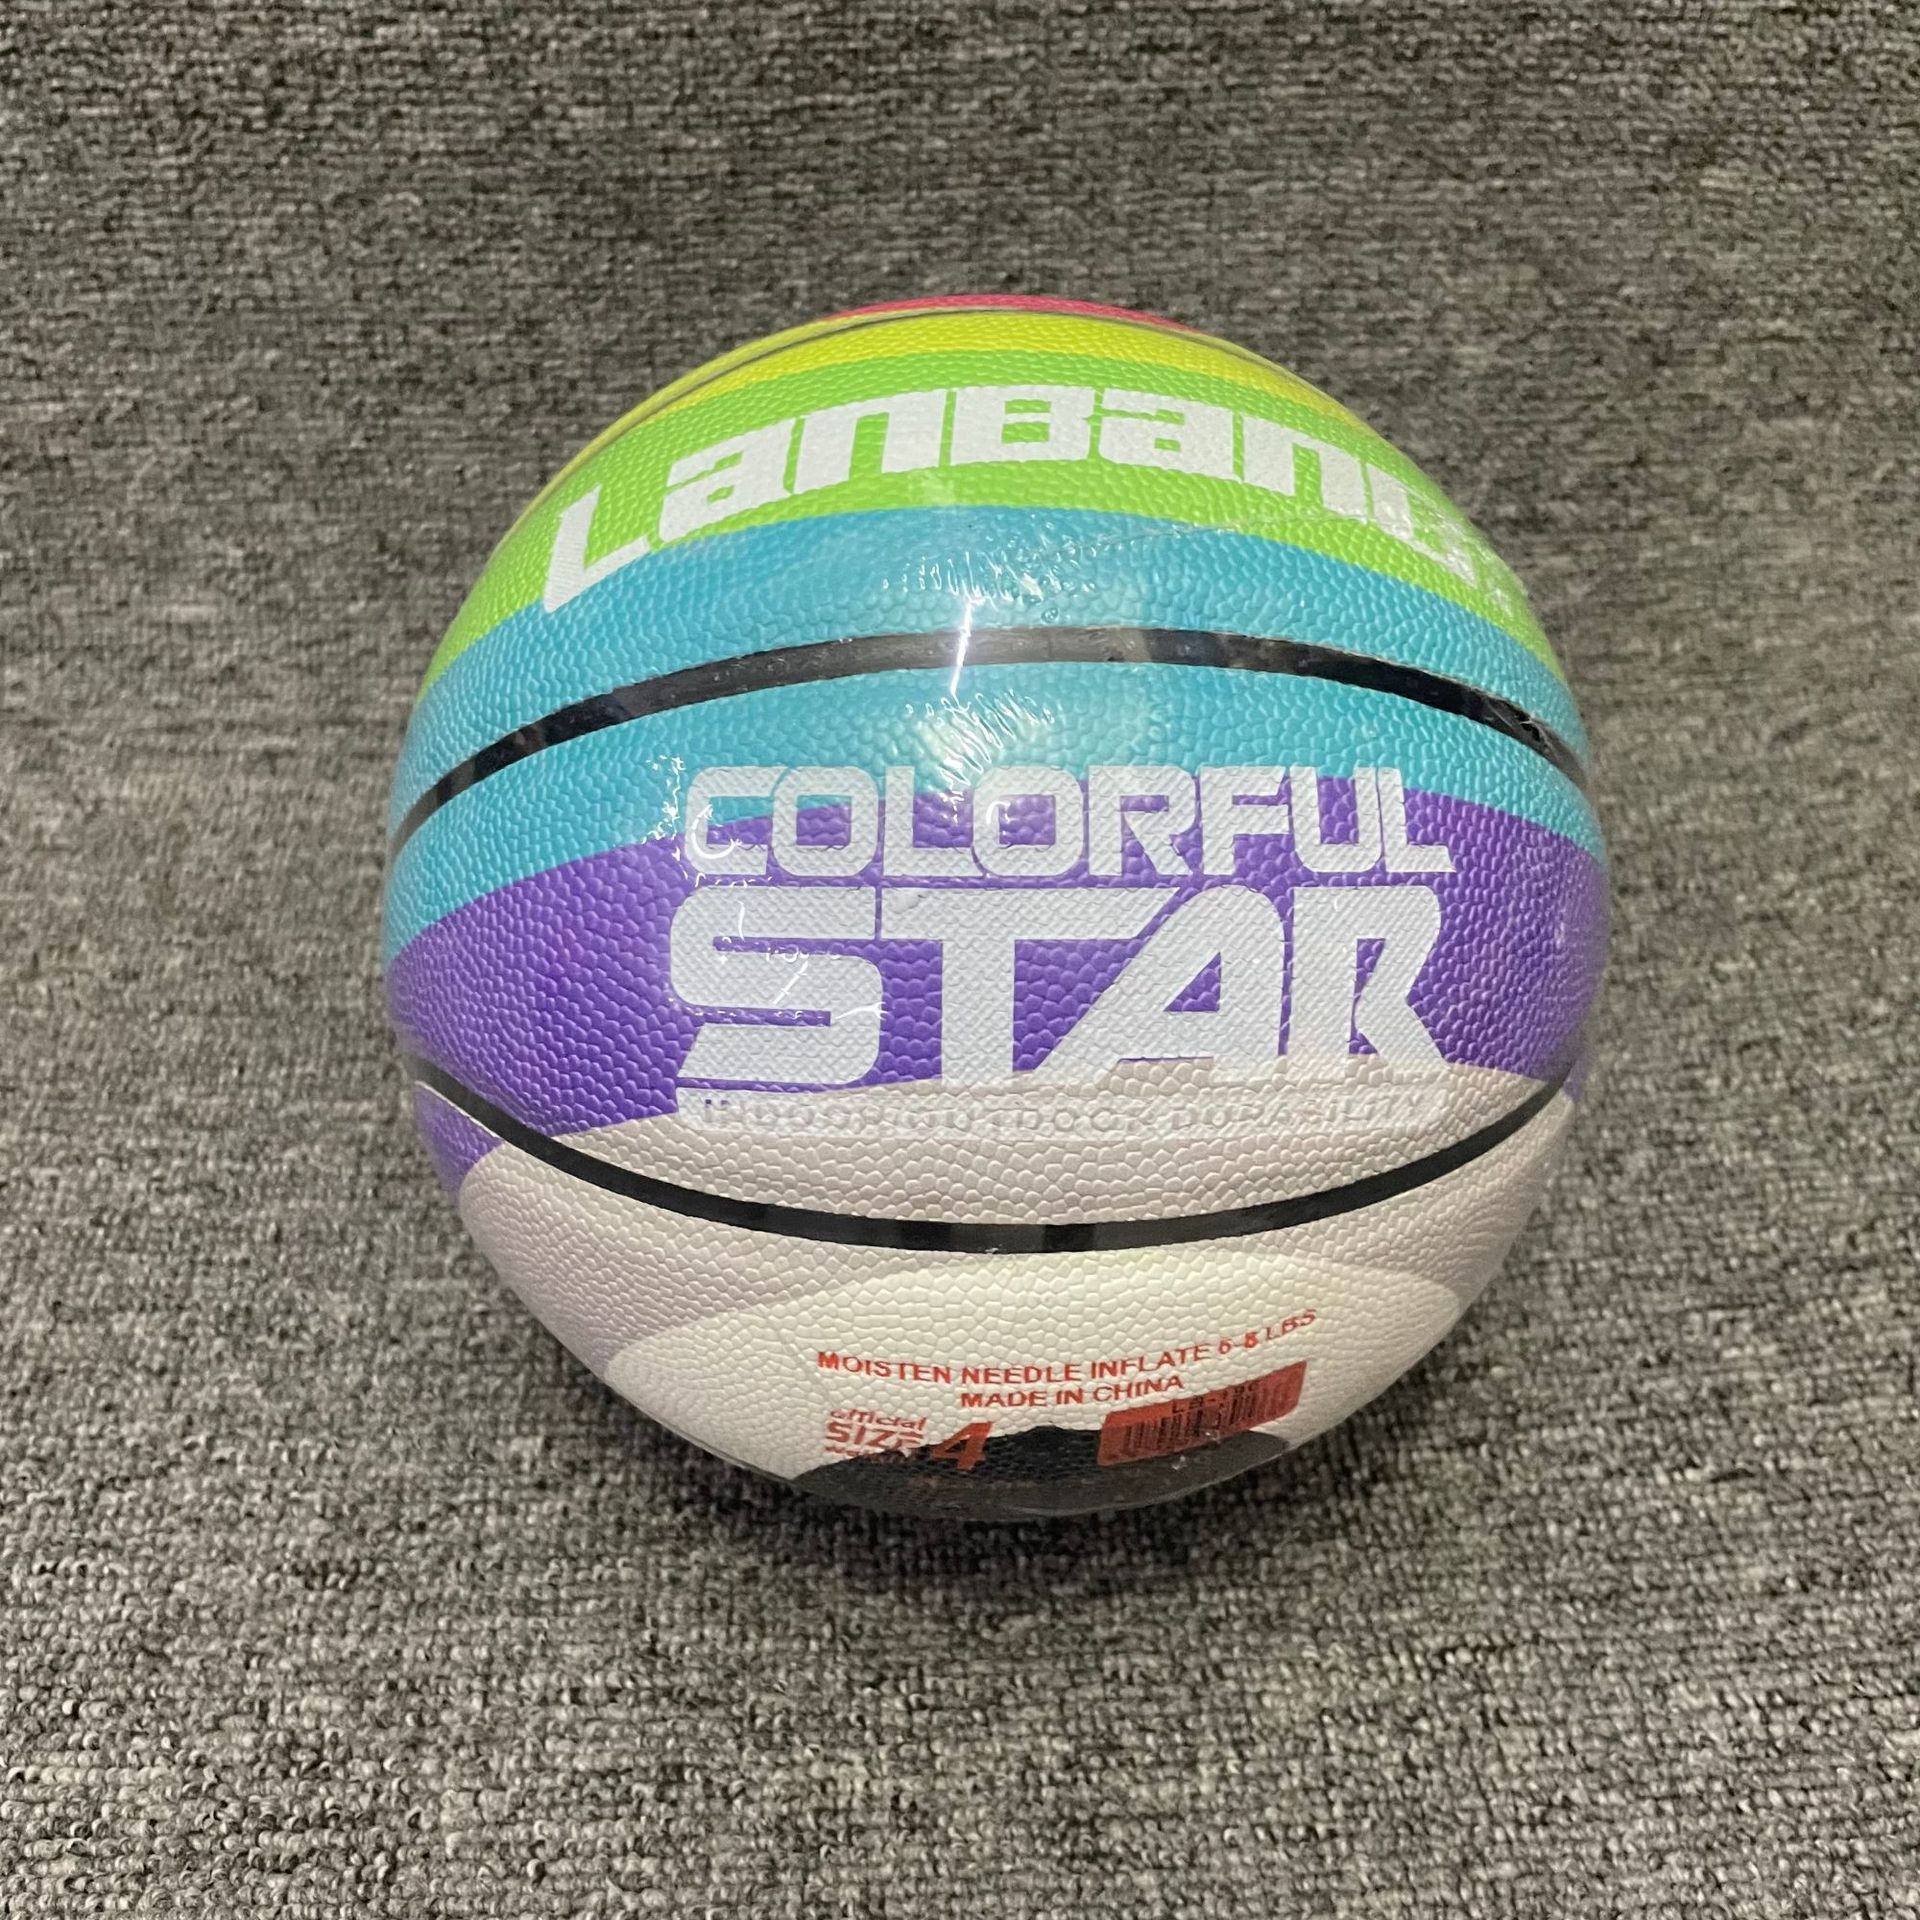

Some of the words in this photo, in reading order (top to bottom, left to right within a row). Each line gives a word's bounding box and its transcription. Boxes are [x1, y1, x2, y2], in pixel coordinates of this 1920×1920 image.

[687, 764, 1455, 879] COLORFUL
[669, 885, 1451, 1088] STAR
[817, 1351, 952, 1384] MOISTEN
[960, 1363, 1082, 1385] NEEDLE
[1090, 1343, 1211, 1379] INFLATE
[1265, 1309, 1317, 1341] LBS
[960, 1391, 1048, 1409] MADE
[1056, 1389, 1085, 1406] IN
[1094, 1375, 1185, 1402] CHINA
[826, 1421, 925, 1450] SIZE
[931, 1420, 995, 1472] 4
